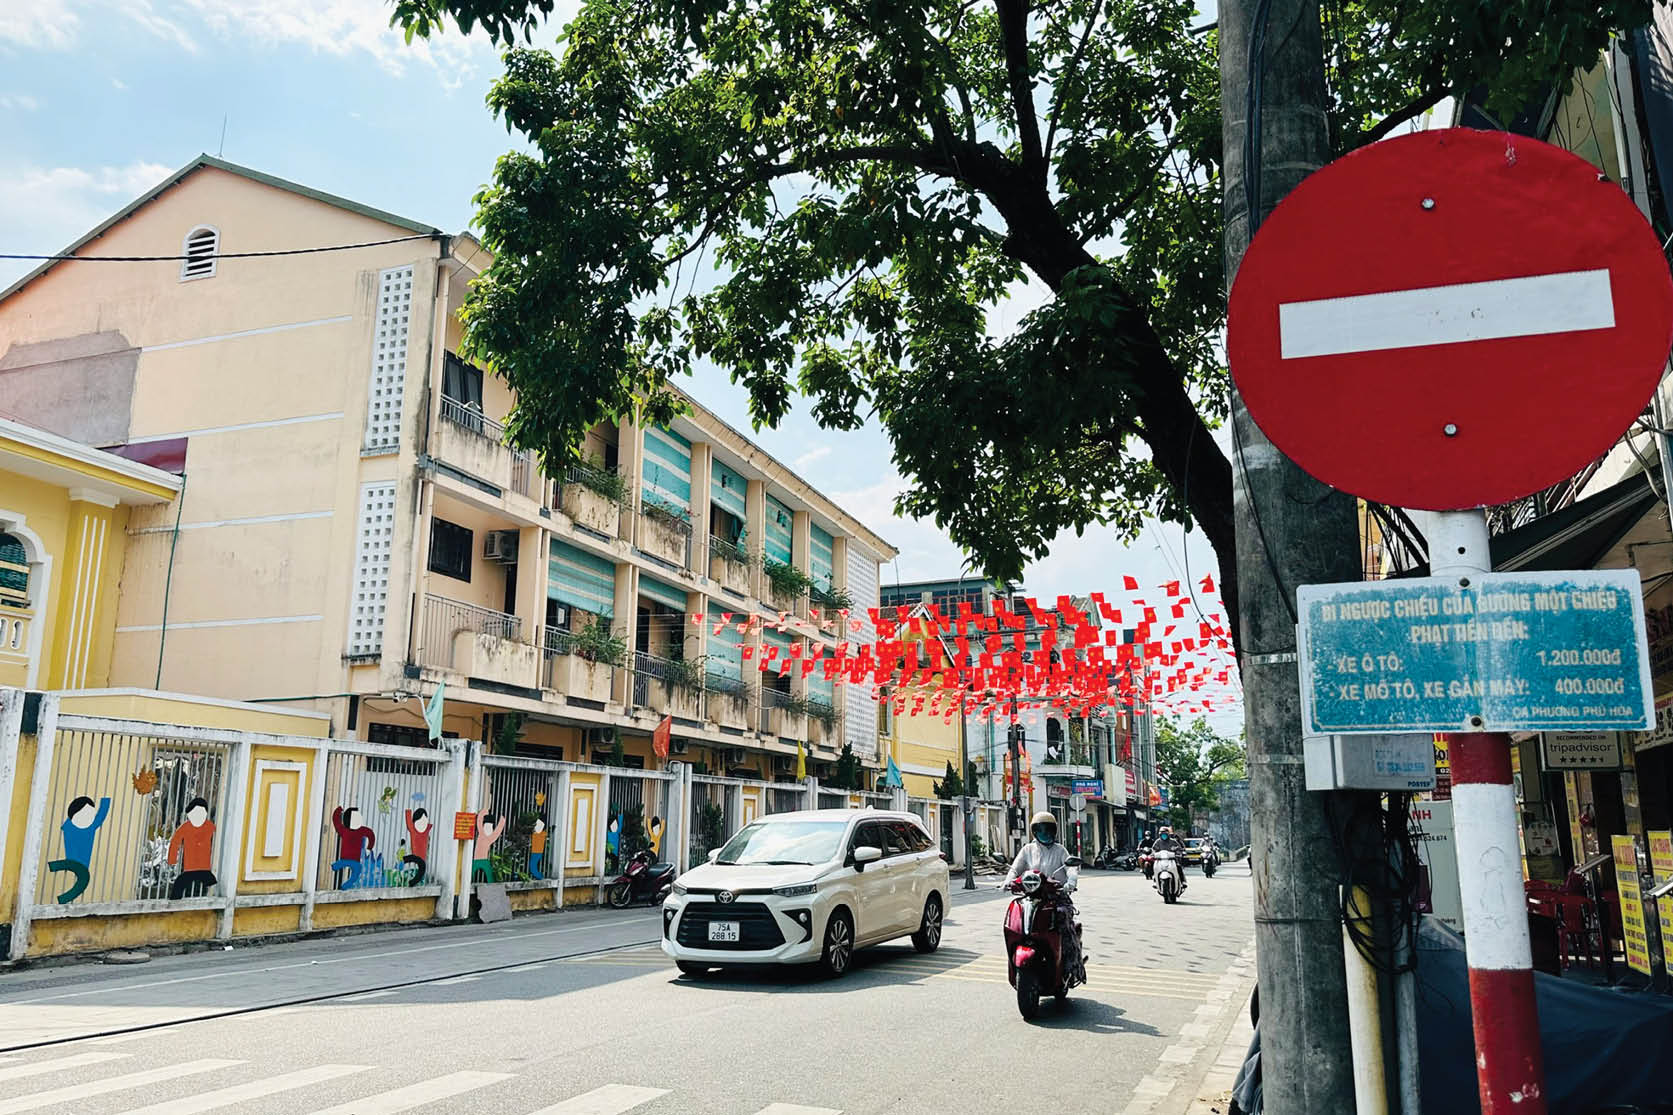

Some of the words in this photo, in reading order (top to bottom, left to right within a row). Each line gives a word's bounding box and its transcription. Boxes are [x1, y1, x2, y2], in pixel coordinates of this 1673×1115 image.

[1337, 656, 1357, 673] XE
[1362, 653, 1374, 672] Ô
[1376, 651, 1404, 672] TÔ:
[1536, 649, 1621, 666] 1.200.000đ
[1339, 684, 1360, 700] XE
[1424, 682, 1446, 698] XE
[1555, 677, 1625, 695] 400.000đ
[1550, 743, 1612, 753] tripadvisor
[718, 923, 730, 931] 75A
